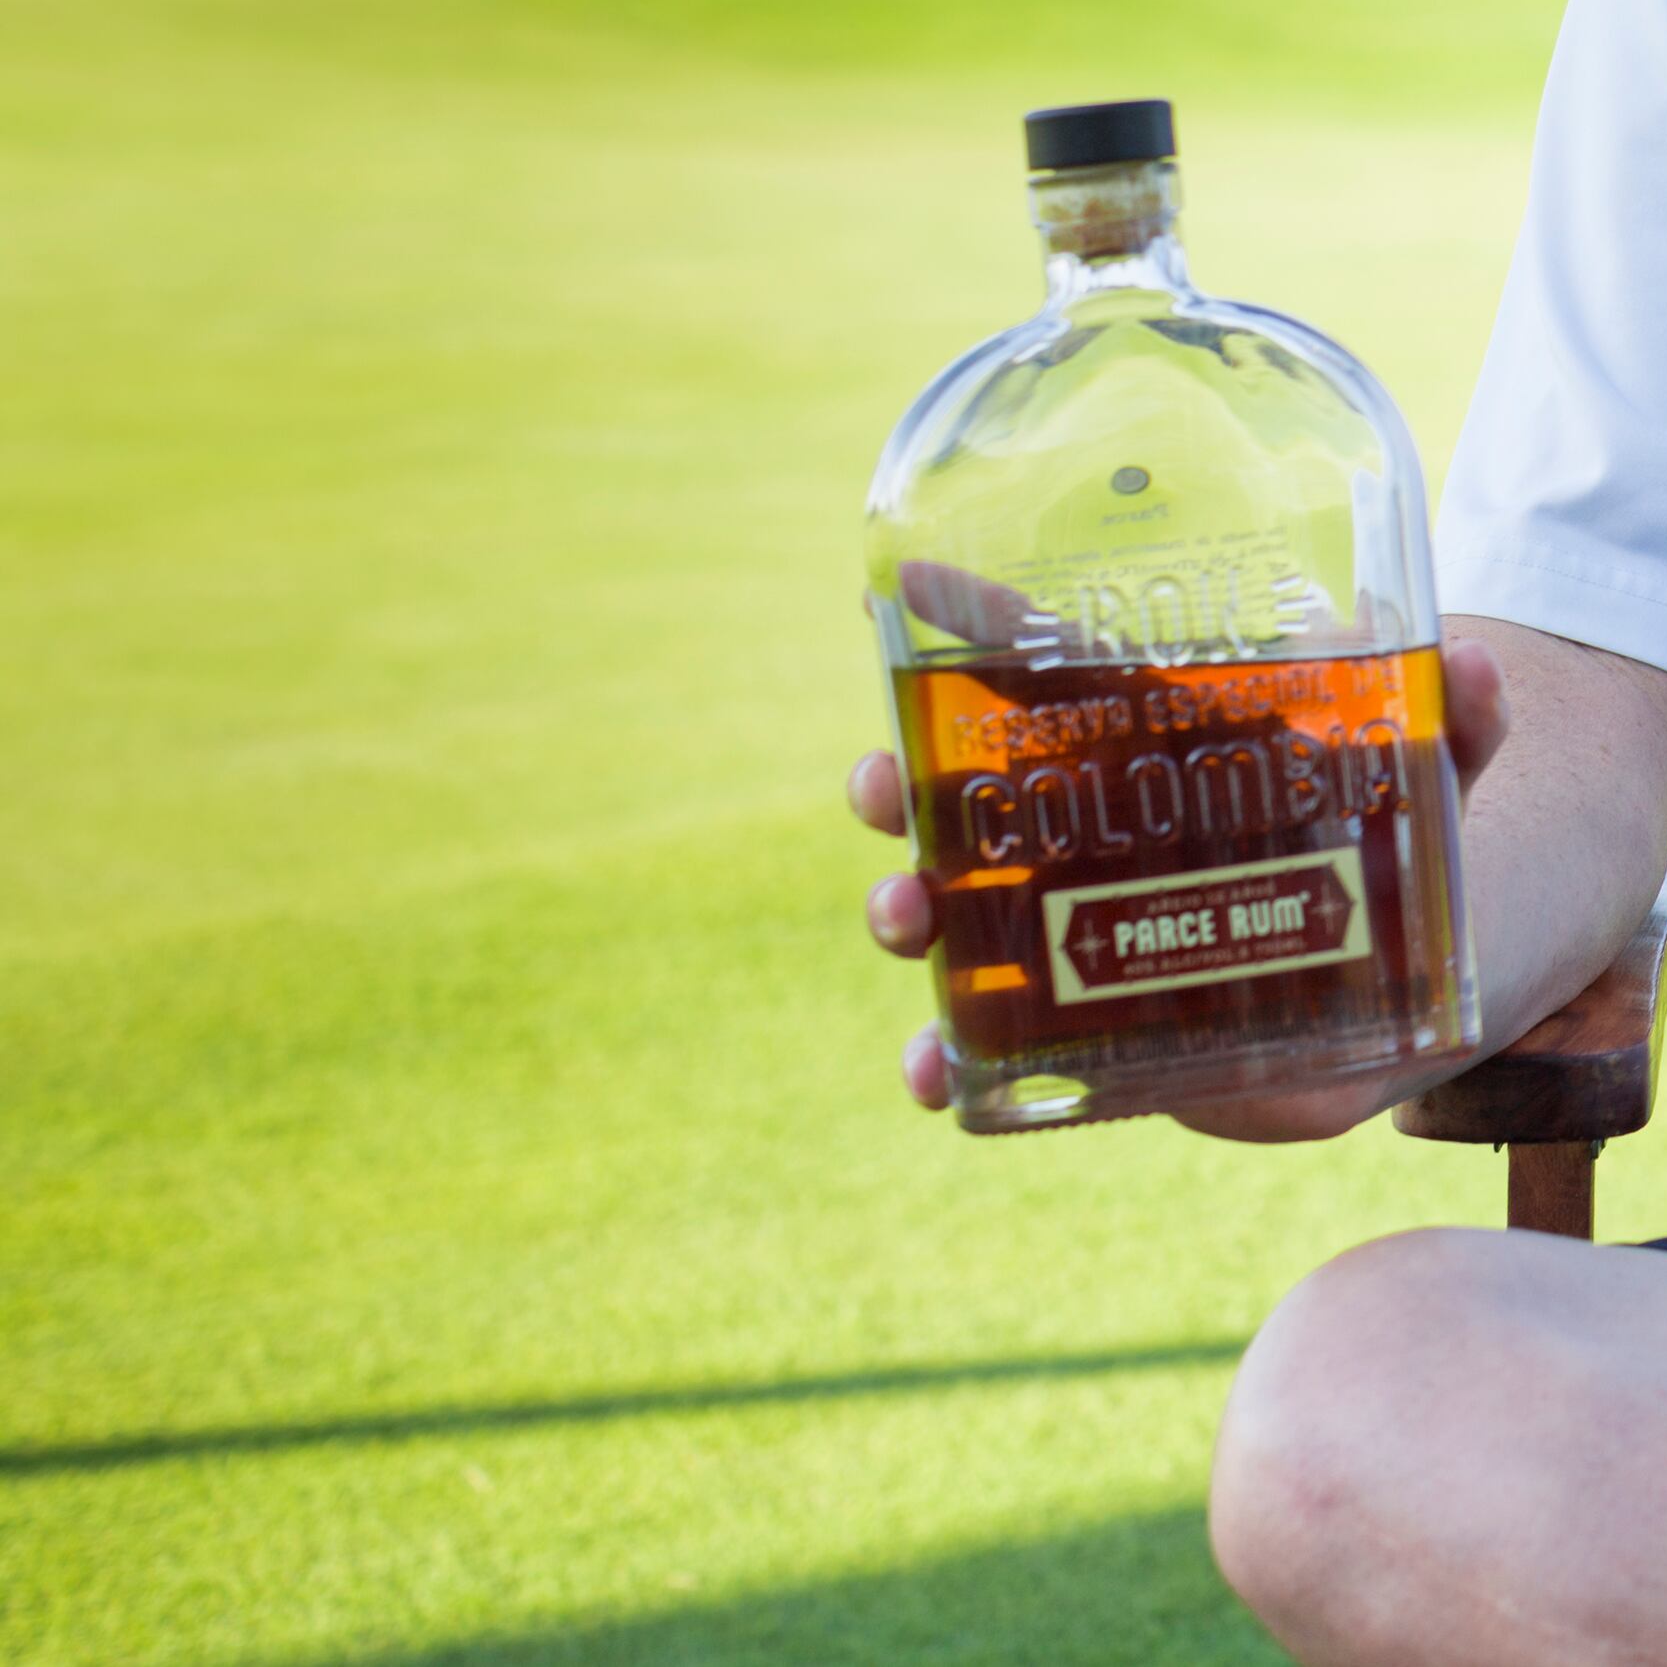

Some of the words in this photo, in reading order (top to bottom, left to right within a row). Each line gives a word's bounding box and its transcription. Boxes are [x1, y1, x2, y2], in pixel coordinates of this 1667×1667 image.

[1144, 665, 1338, 734] ESPECIAL
[961, 718, 1411, 862] COLOMBIA
[1112, 908, 1218, 959] PARCE
